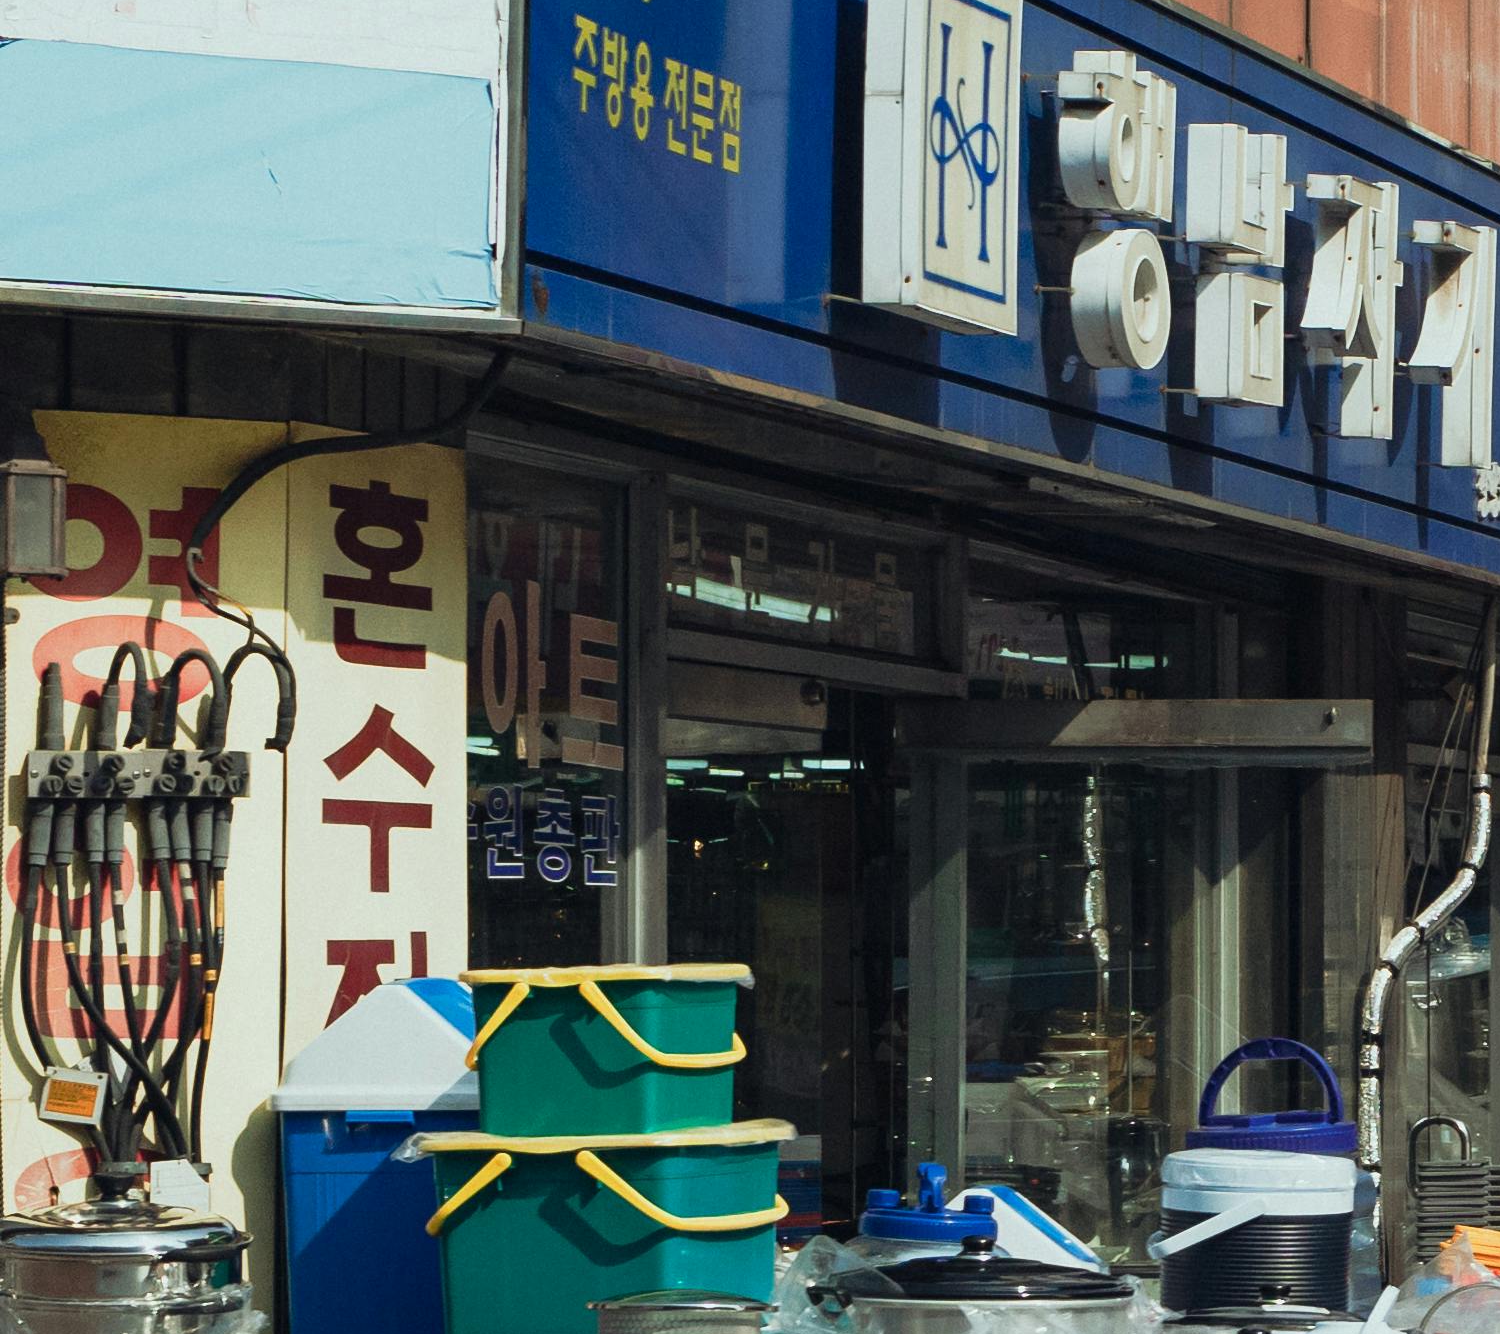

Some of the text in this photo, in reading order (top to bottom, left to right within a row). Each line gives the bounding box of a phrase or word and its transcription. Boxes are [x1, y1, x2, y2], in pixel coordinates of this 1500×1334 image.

[573, 13, 742, 174] 주방용 전문점
[482, 580, 622, 768] 아트
[468, 784, 622, 888] 원총판
